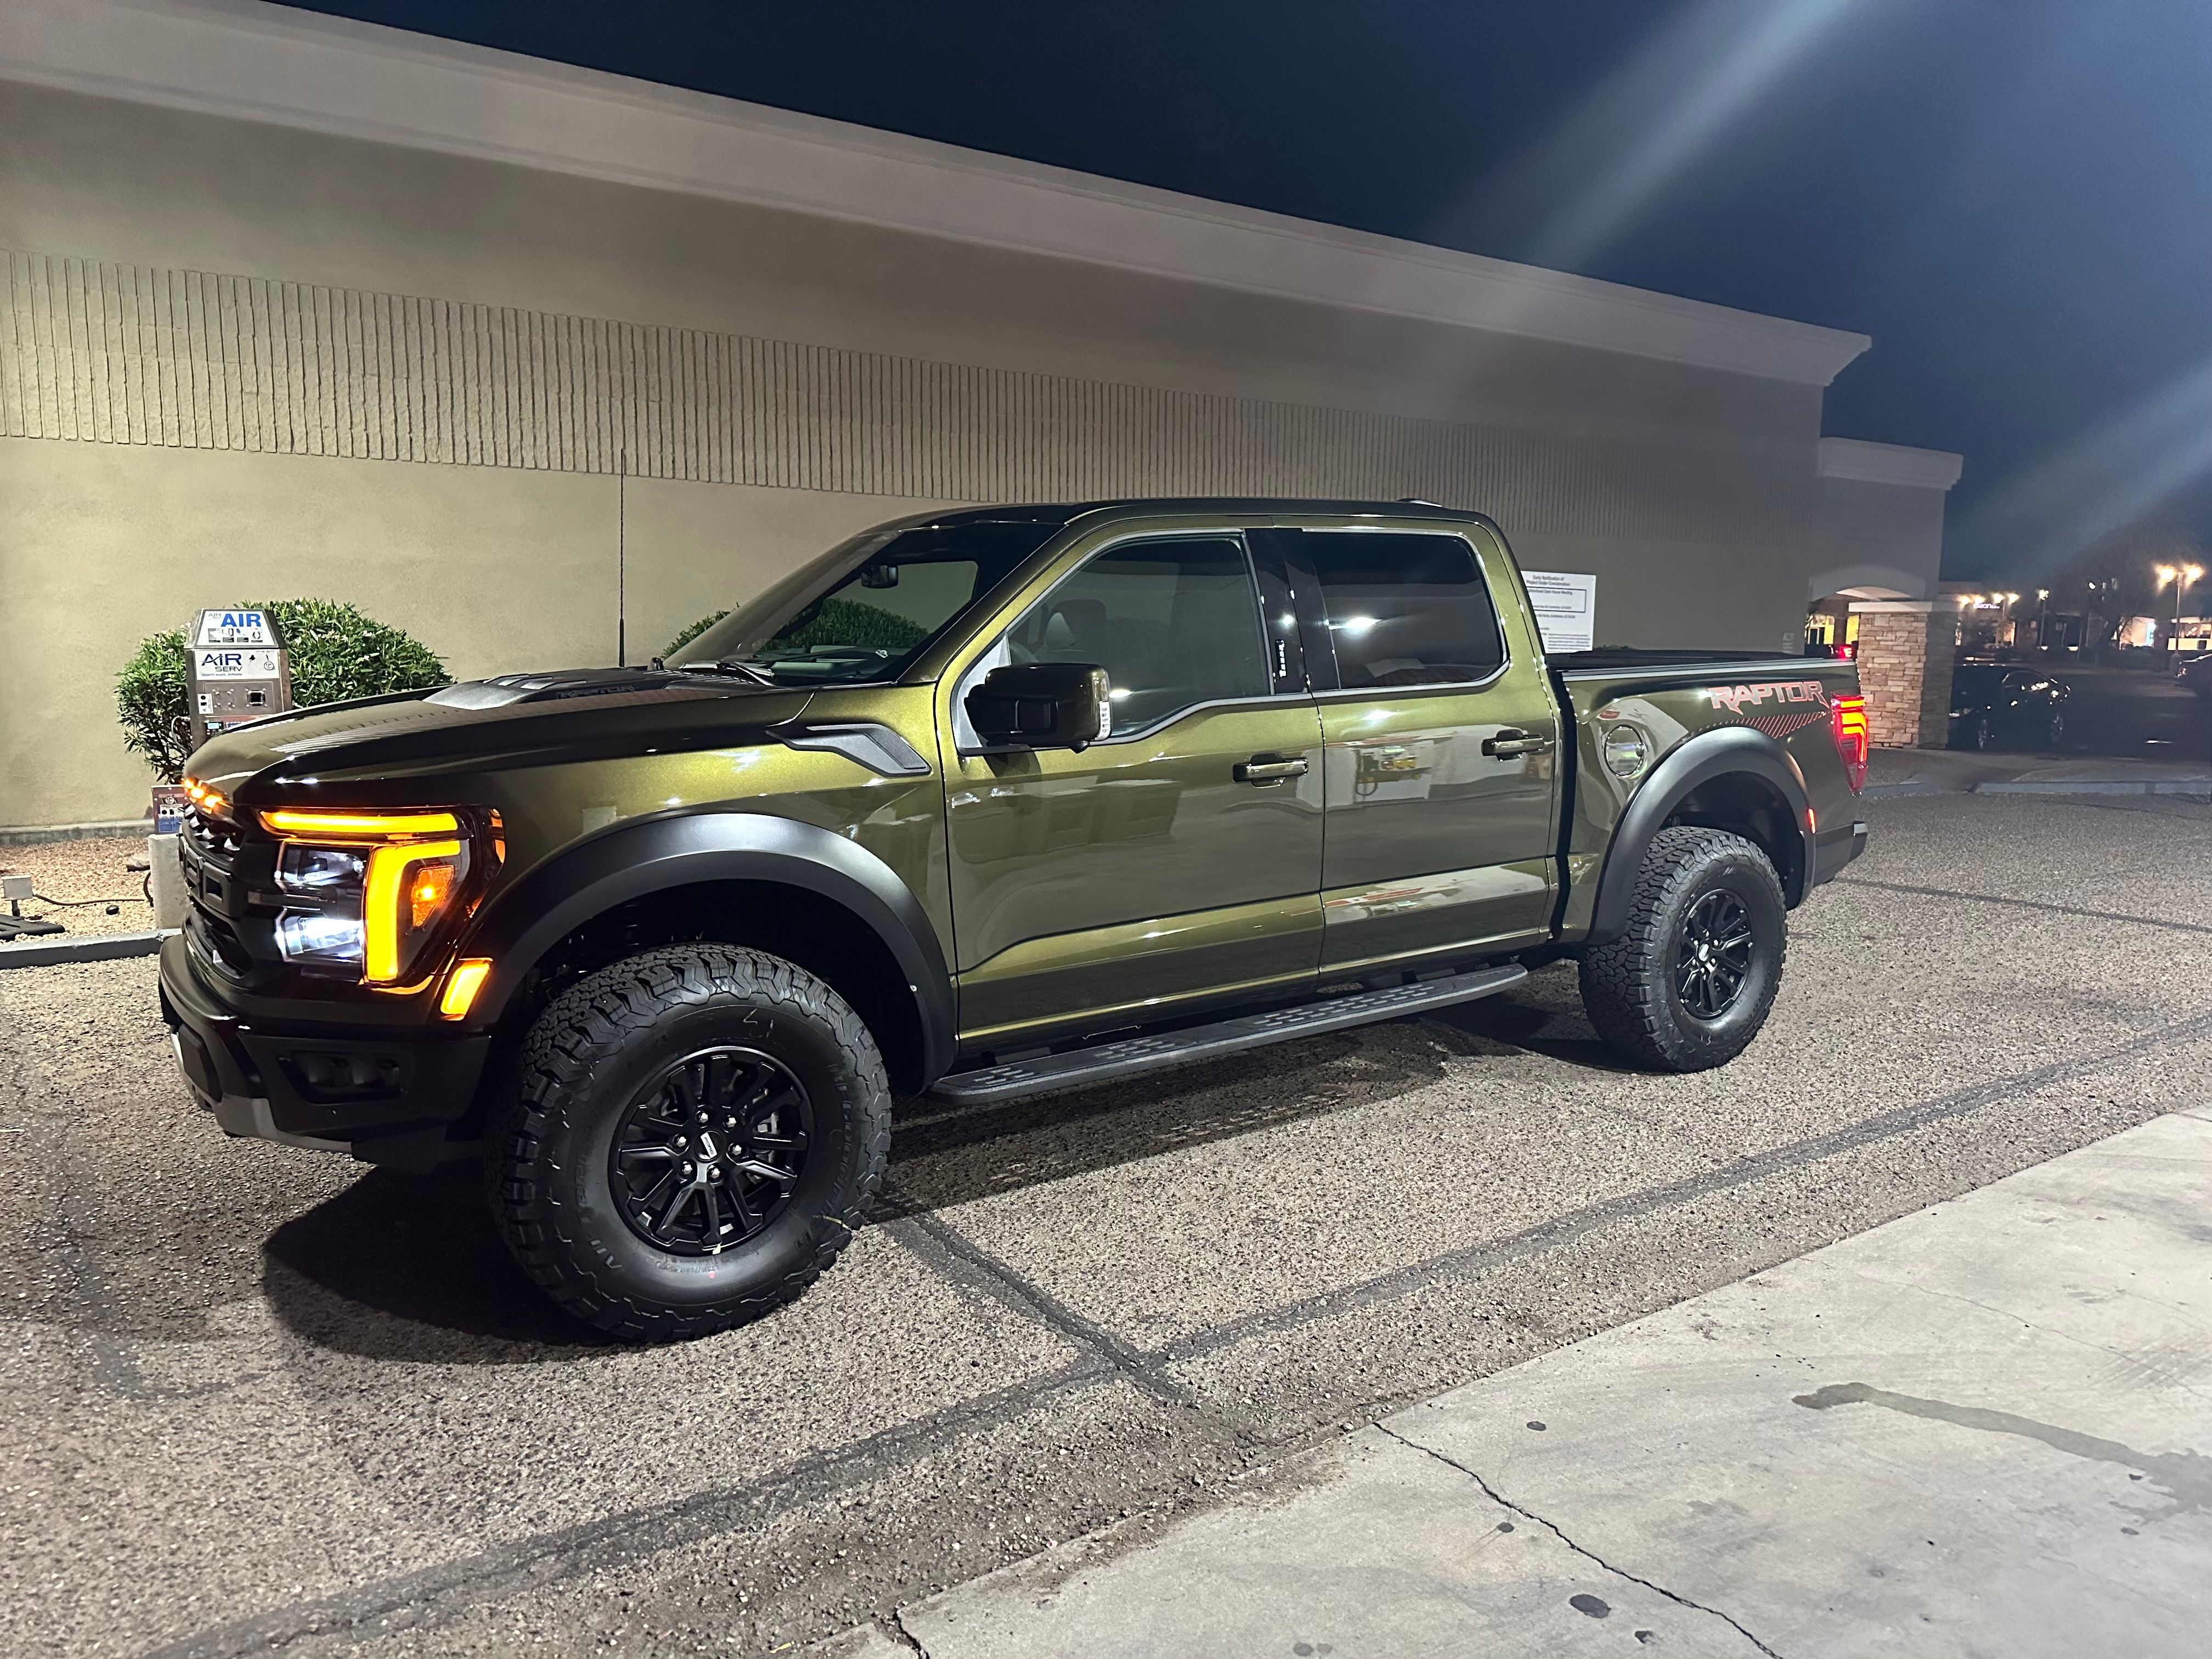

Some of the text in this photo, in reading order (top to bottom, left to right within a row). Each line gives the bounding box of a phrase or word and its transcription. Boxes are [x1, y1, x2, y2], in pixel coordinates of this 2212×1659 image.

[221, 613, 261, 627] AIR
[201, 653, 242, 666] AIR
[1707, 681, 1830, 715] RAPTOR
[704, 1137, 714, 1155] FORD
